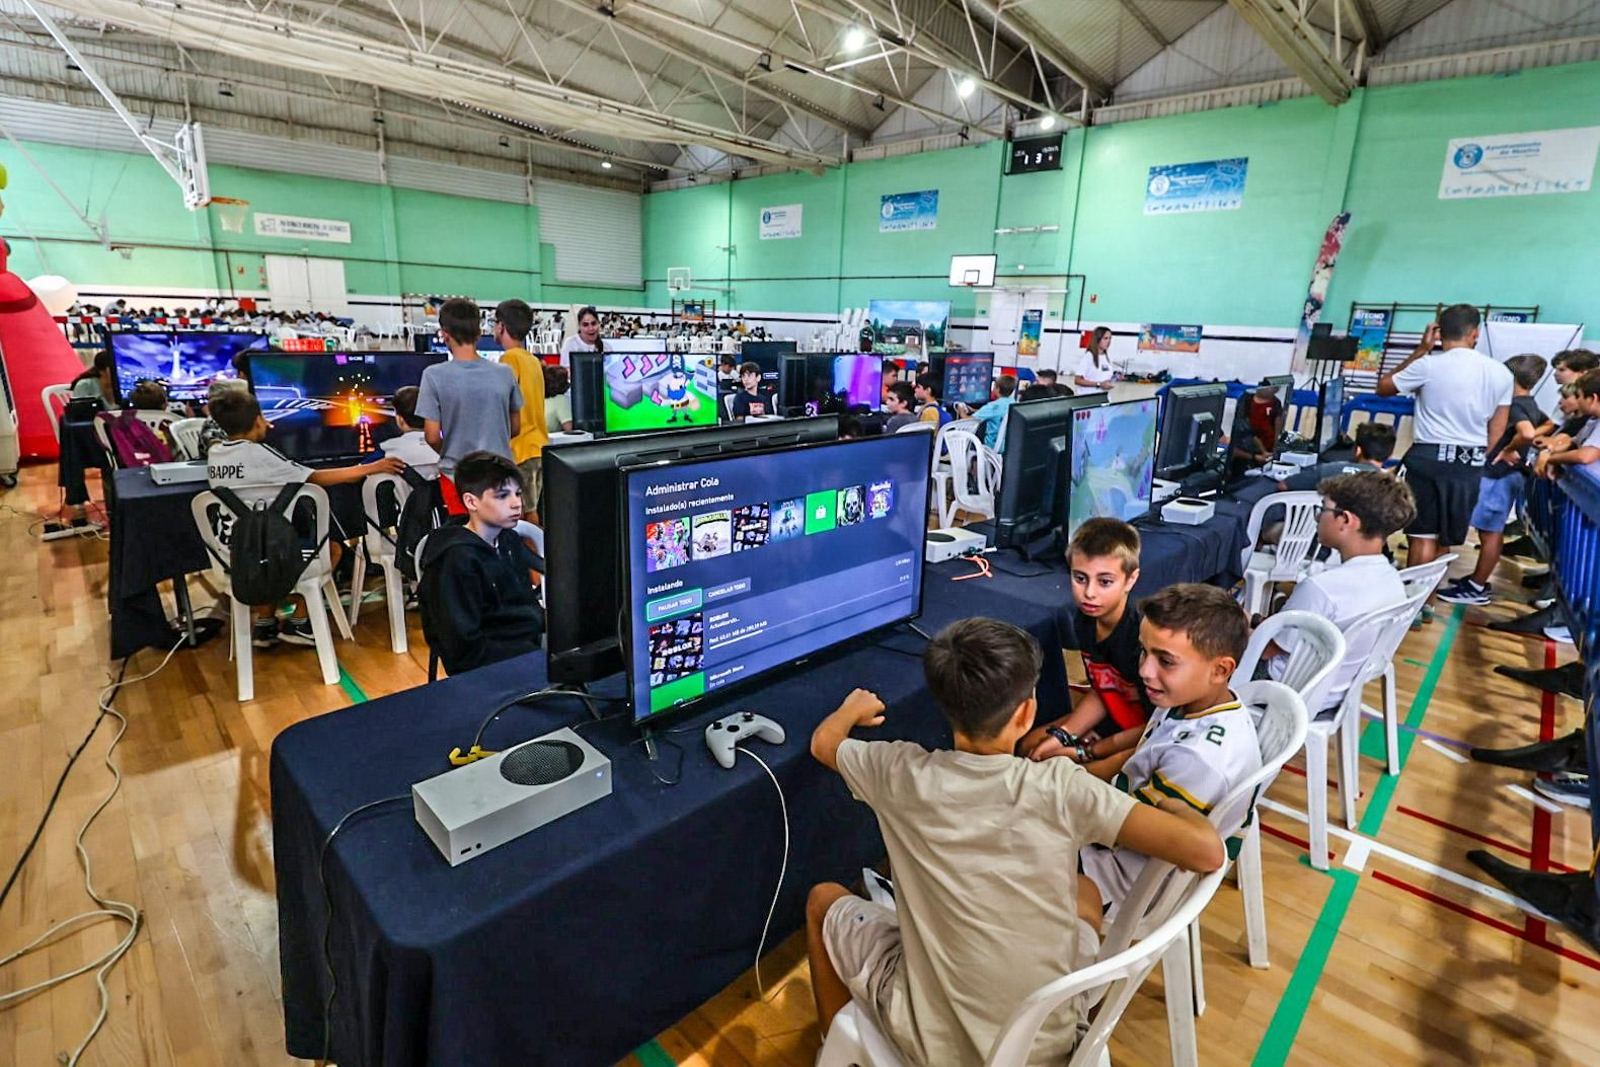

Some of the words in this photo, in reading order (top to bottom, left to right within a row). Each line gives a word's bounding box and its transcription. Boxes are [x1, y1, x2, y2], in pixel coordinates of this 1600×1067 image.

[645, 481, 699, 497] Administrar
[700, 476, 720, 488] Cola
[645, 500, 688, 516] Instalado(s)
[688, 493, 735, 508] recientemente
[647, 579, 684, 595] Instalando
[661, 641, 693, 656] ROBLOX
[1206, 725, 1226, 746] 2
